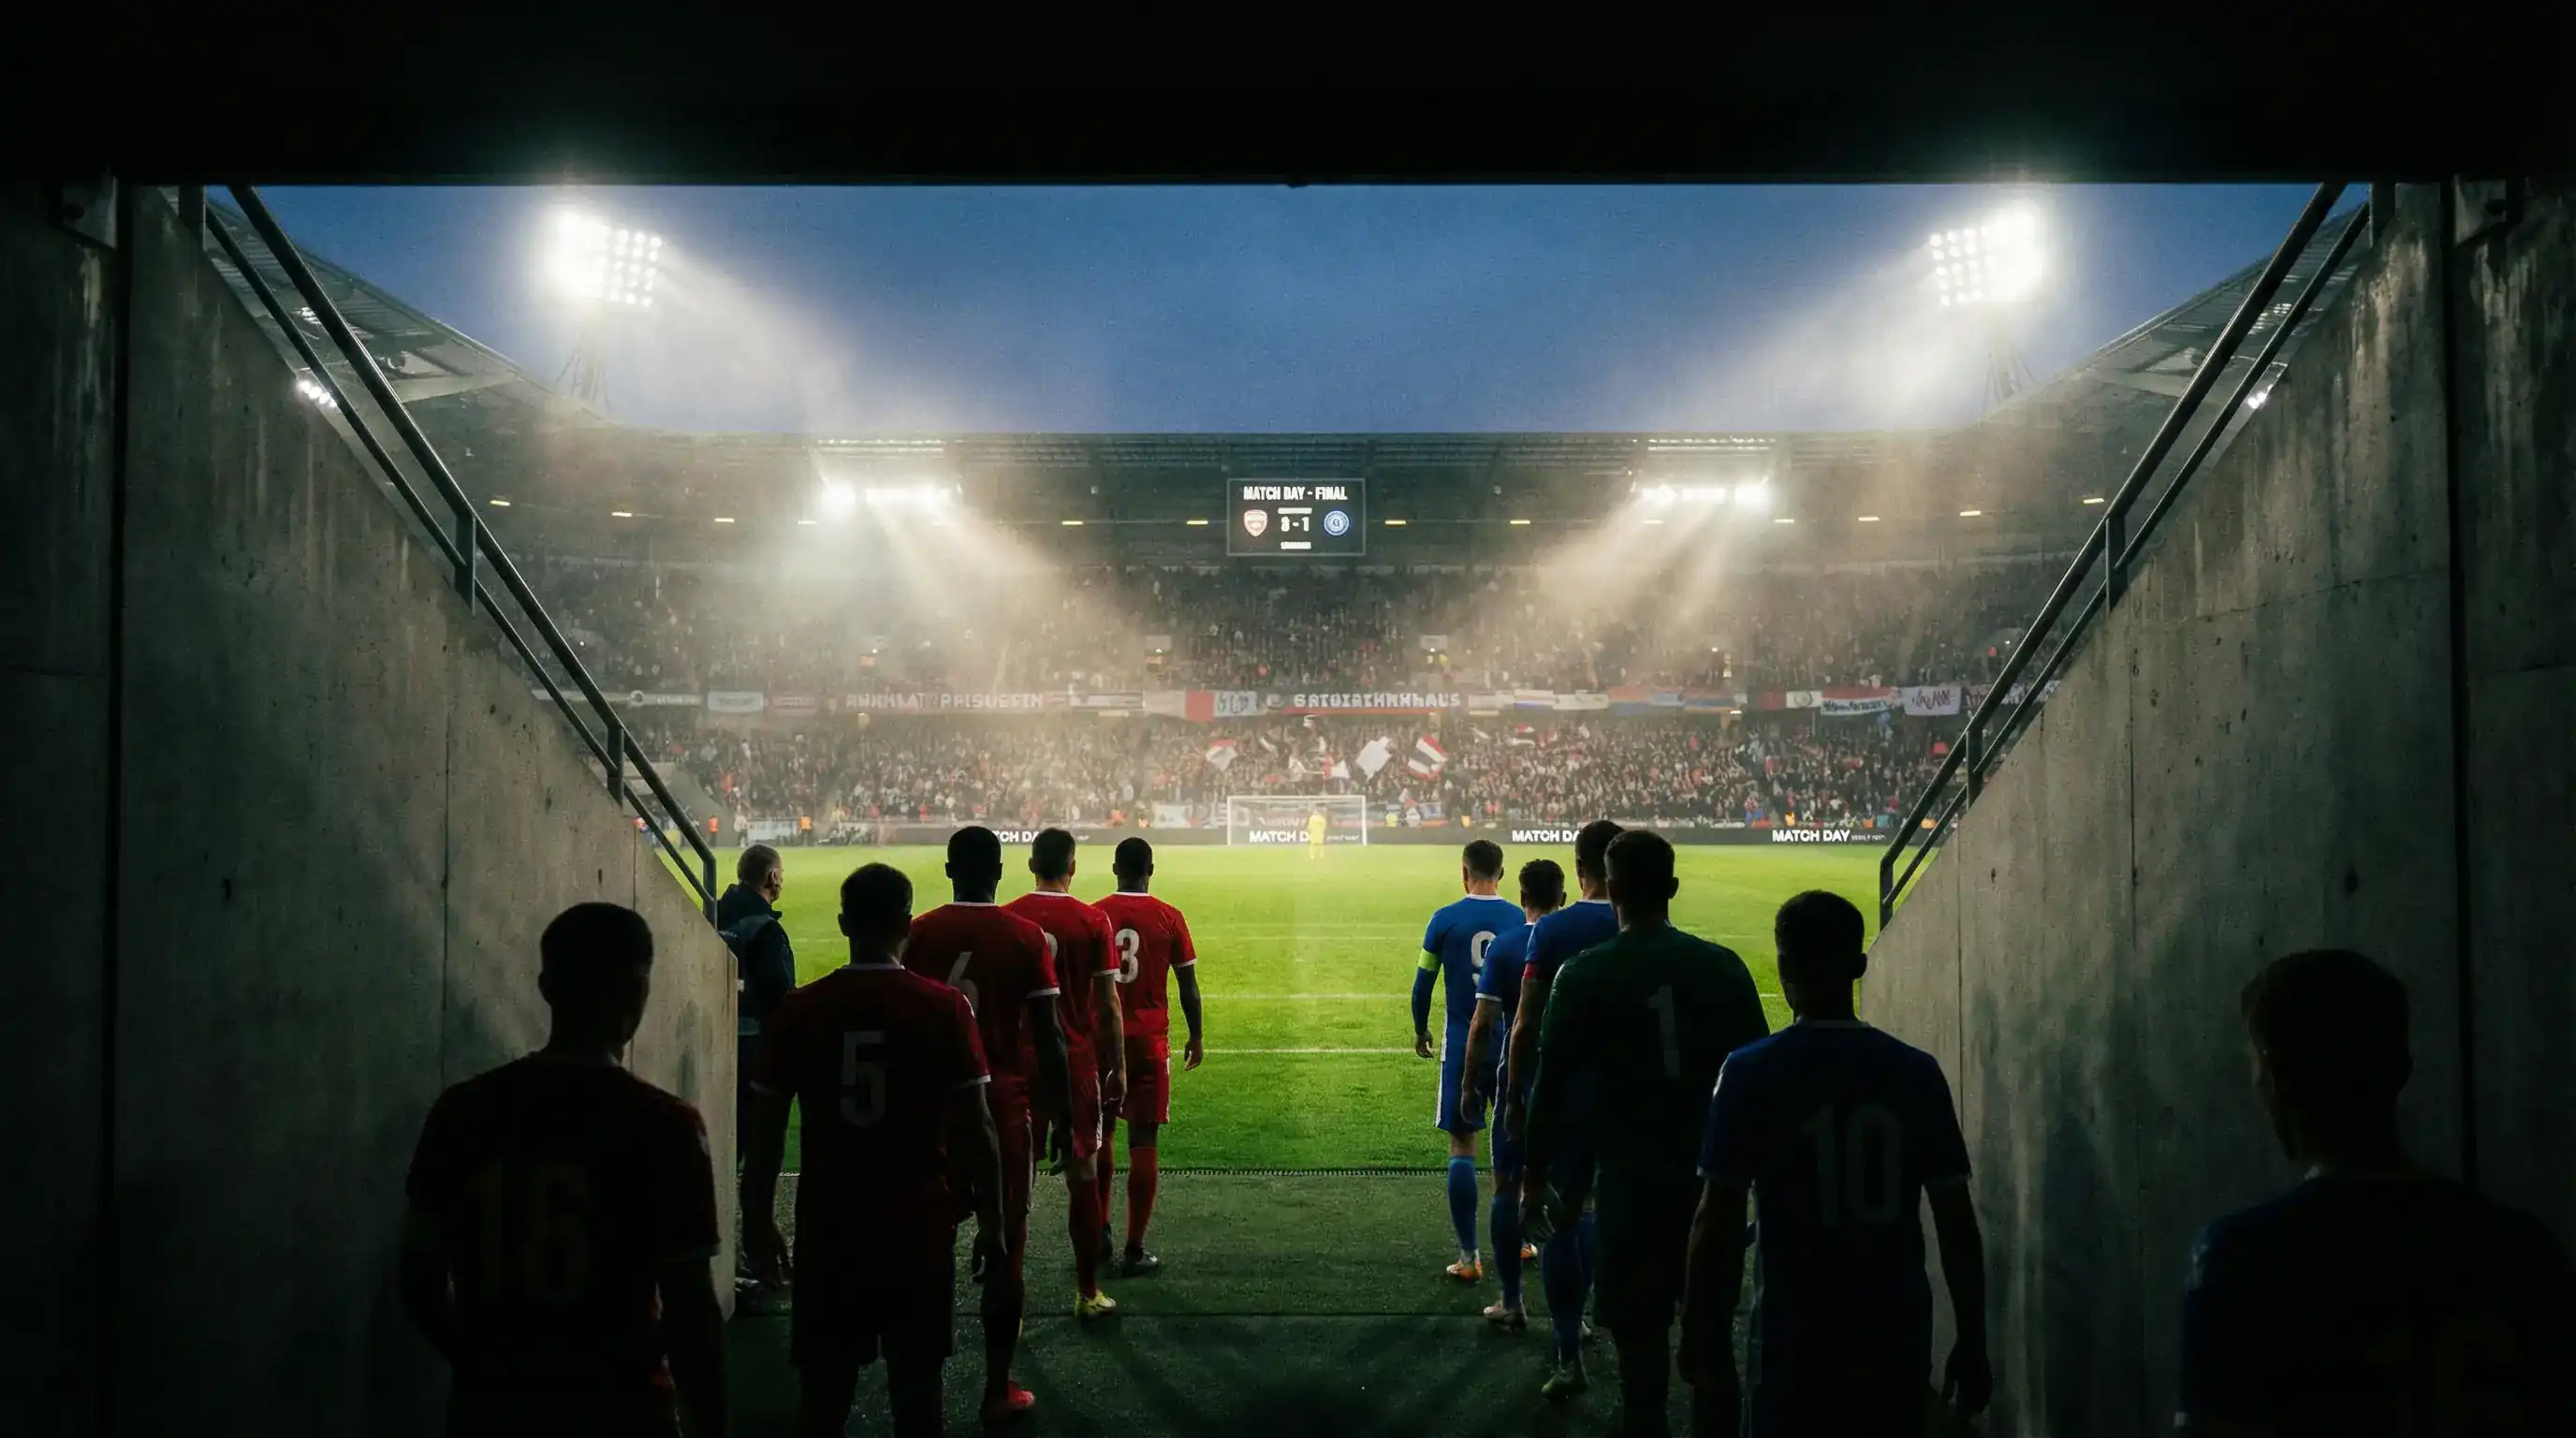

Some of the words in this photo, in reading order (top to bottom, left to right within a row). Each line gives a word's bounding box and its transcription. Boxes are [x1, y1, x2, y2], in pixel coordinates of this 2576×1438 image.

[1243, 486, 1281, 501] MATCH
[1283, 486, 1306, 501] DAY
[1315, 486, 1349, 501] FINAL
[1301, 516, 1310, 532] 1
[1250, 830, 1296, 843] MATCH
[1512, 829, 1559, 842] MATCH
[1772, 829, 1820, 842] MATCH
[1822, 829, 1851, 842] DAY
[1115, 928, 1140, 984] 3
[1647, 983, 1681, 1080] 1
[840, 1029, 888, 1128] 5
[1797, 1102, 1904, 1225] 10
